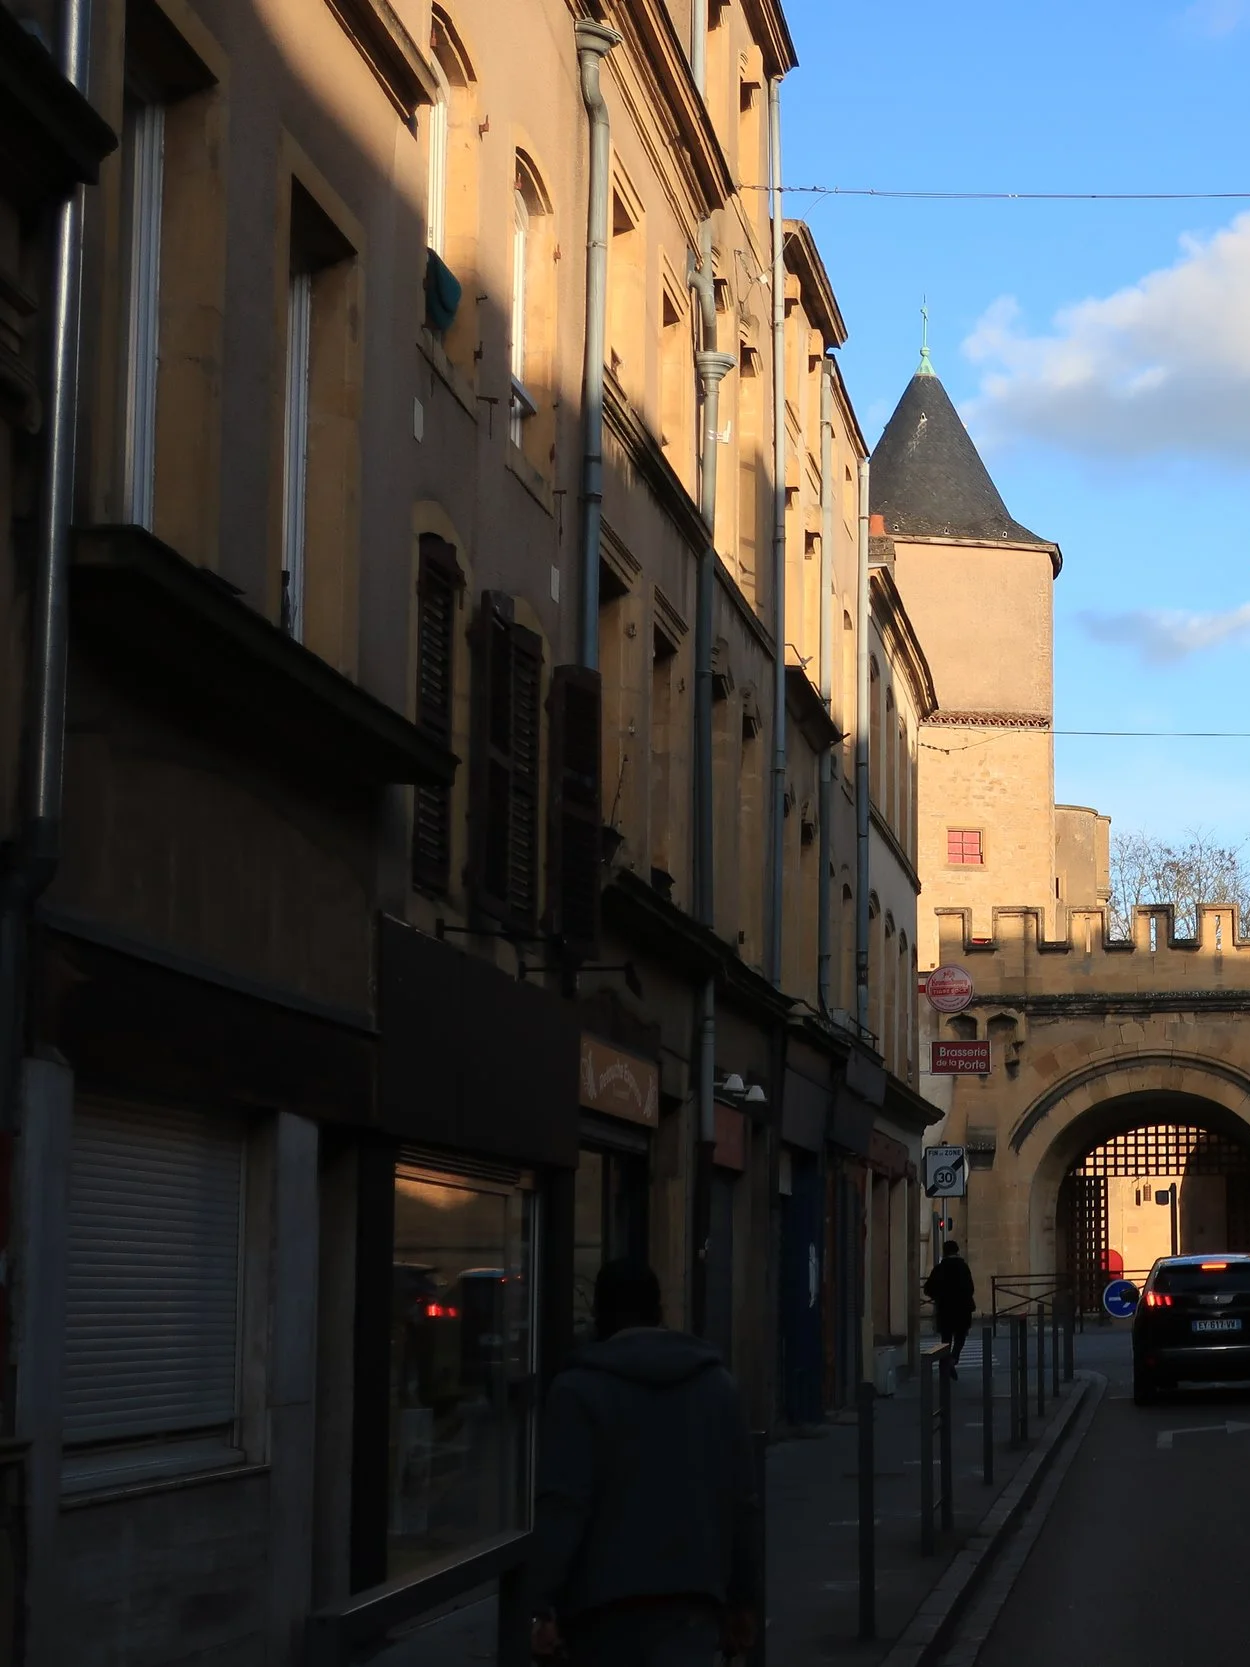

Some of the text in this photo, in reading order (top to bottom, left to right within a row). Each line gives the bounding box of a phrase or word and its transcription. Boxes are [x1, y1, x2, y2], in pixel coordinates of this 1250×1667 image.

[939, 1047, 988, 1058] Brasserie
[936, 1059, 947, 1067] de
[958, 1060, 986, 1070] Porte
[938, 1172, 953, 1183] 30
